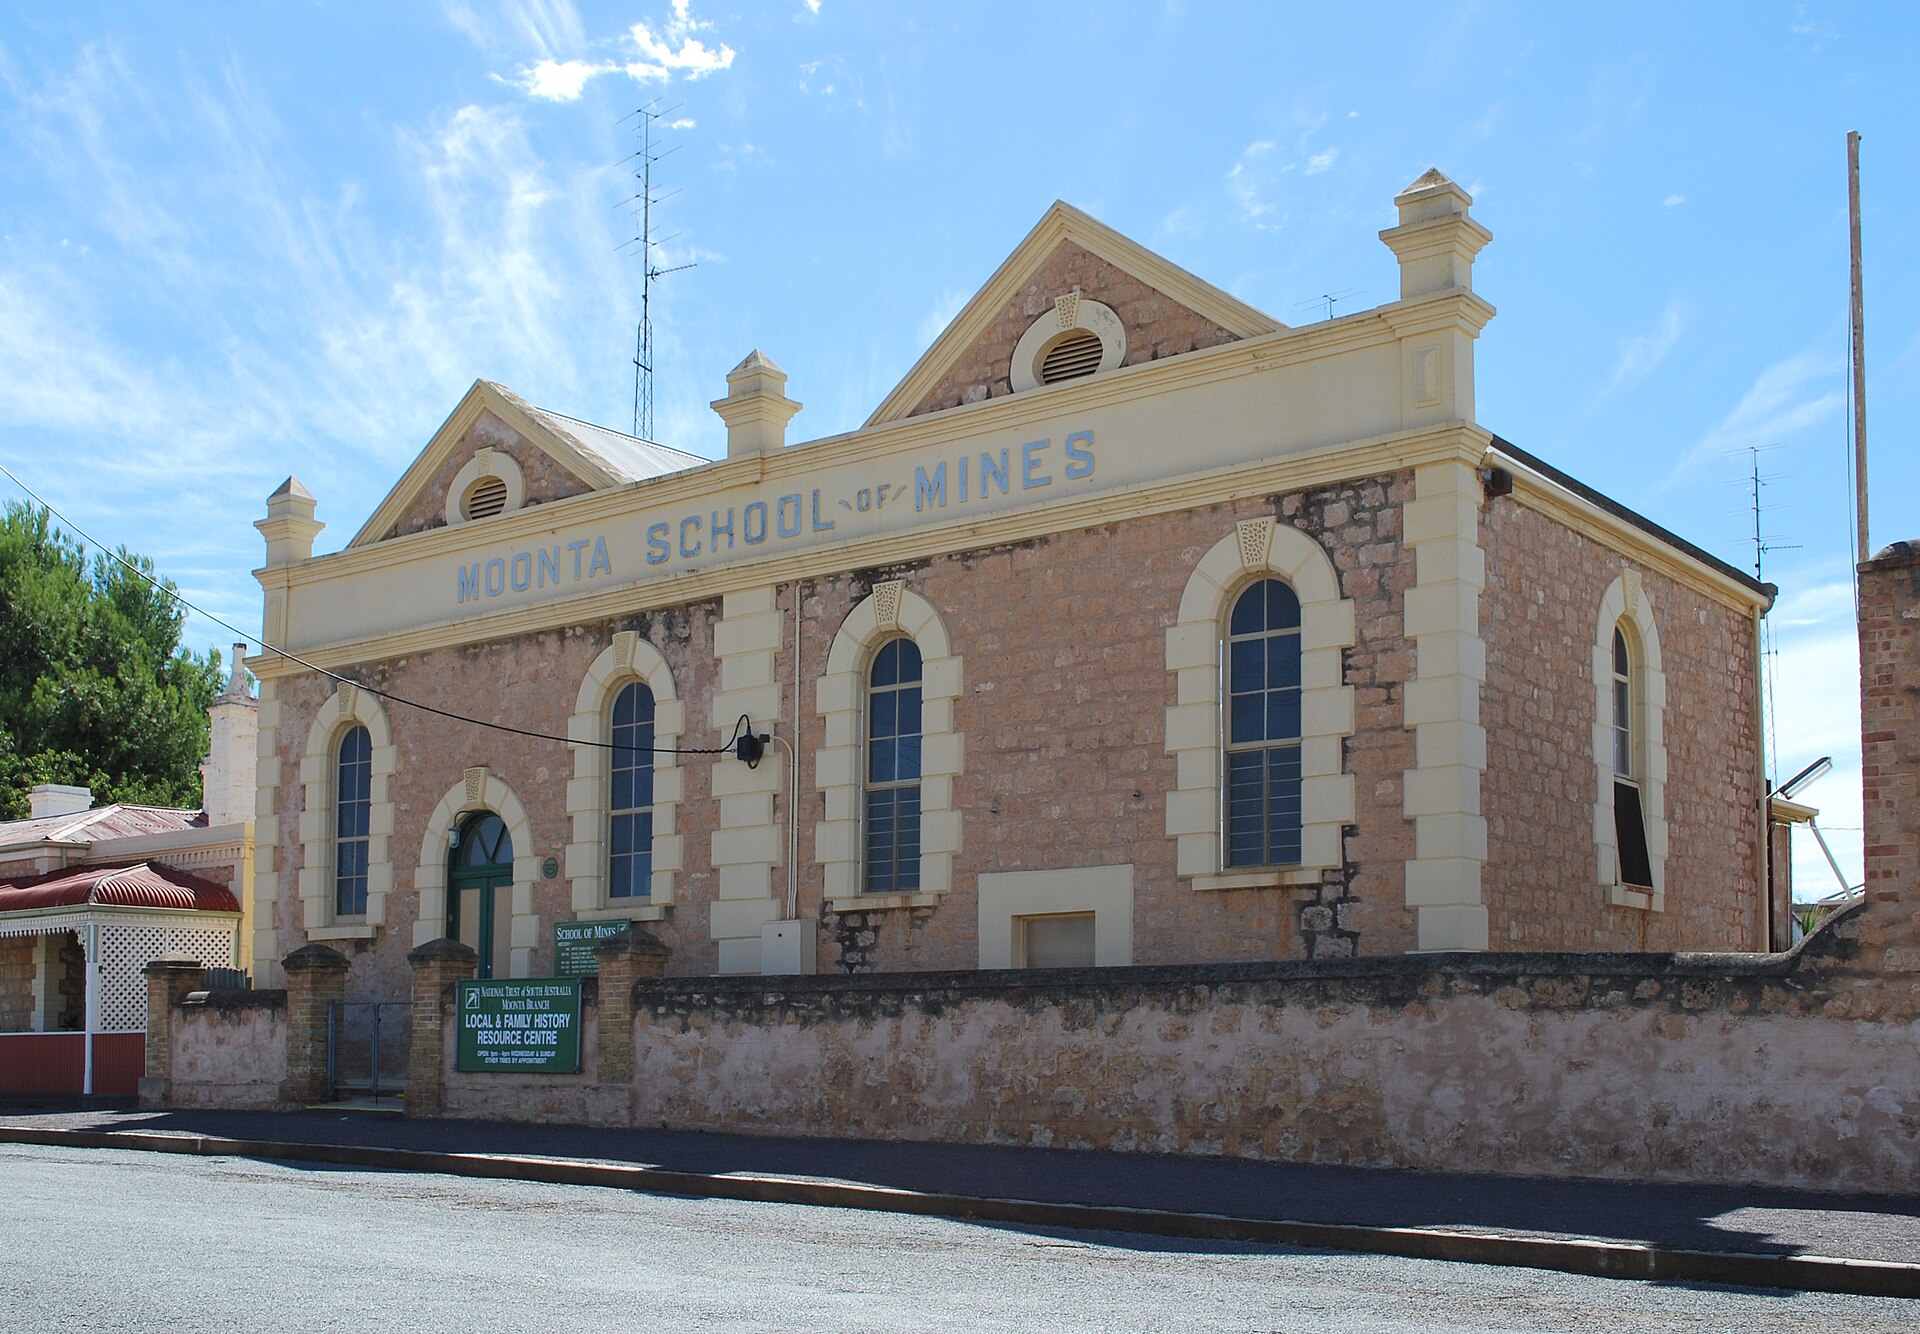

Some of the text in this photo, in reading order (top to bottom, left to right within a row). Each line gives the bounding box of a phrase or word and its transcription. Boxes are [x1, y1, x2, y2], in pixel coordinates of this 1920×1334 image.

[457, 429, 1095, 604] MOONTA SCHOOL OF MINES
[557, 925, 616, 940] SCHOOL OF MINES
[481, 986, 505, 997] NATIONAL
[505, 986, 520, 997] TRUST
[526, 986, 543, 997] SOUTH
[543, 985, 572, 996] AUSTRALIA
[502, 999, 550, 1010] MOONTA BRANCH
[465, 1013, 571, 1028] LOCAL & FAMILY HISTORY
[477, 1030, 557, 1045] RESOURCE CENTRE
